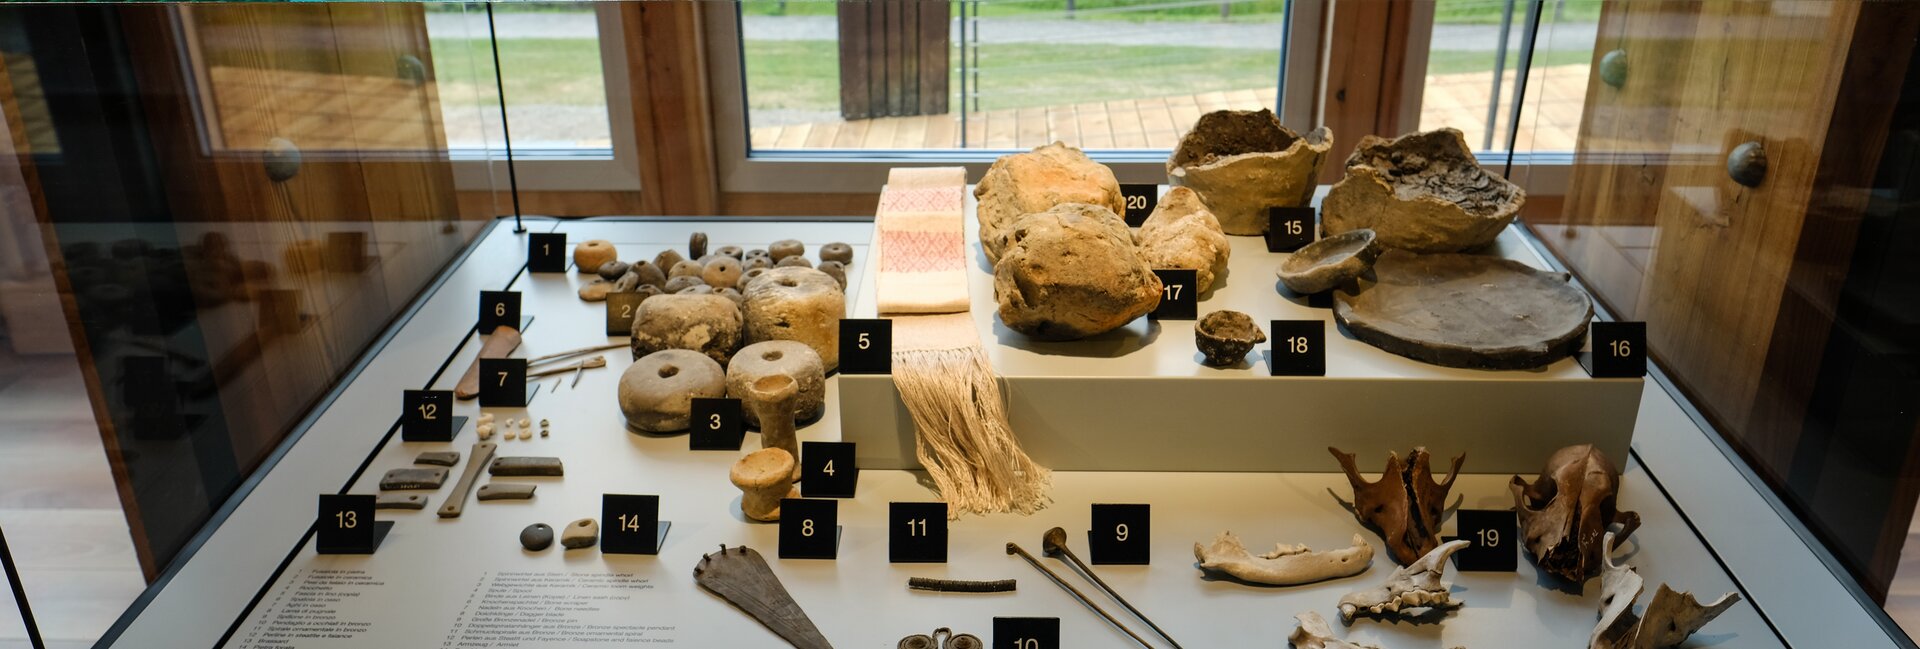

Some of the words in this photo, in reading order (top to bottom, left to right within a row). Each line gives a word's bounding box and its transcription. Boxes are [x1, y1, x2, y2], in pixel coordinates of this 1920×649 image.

[1127, 196, 1147, 210] 20
[1285, 221, 1302, 234] 15
[541, 244, 549, 256] 1
[1164, 285, 1182, 300] 17
[496, 303, 505, 316] 6
[621, 304, 632, 319] 2
[859, 333, 870, 349] 5
[1288, 337, 1307, 353] 18
[1610, 340, 1630, 356] 16
[498, 372, 507, 386] 7
[419, 404, 436, 419] 12
[710, 414, 720, 429] 3
[824, 460, 834, 476] 4
[336, 511, 356, 528] 13
[619, 514, 639, 531] 14
[802, 519, 814, 536] 8
[908, 519, 925, 536] 11
[1117, 524, 1128, 541] 9
[1477, 529, 1499, 547] 19
[1014, 638, 1039, 649] 10
